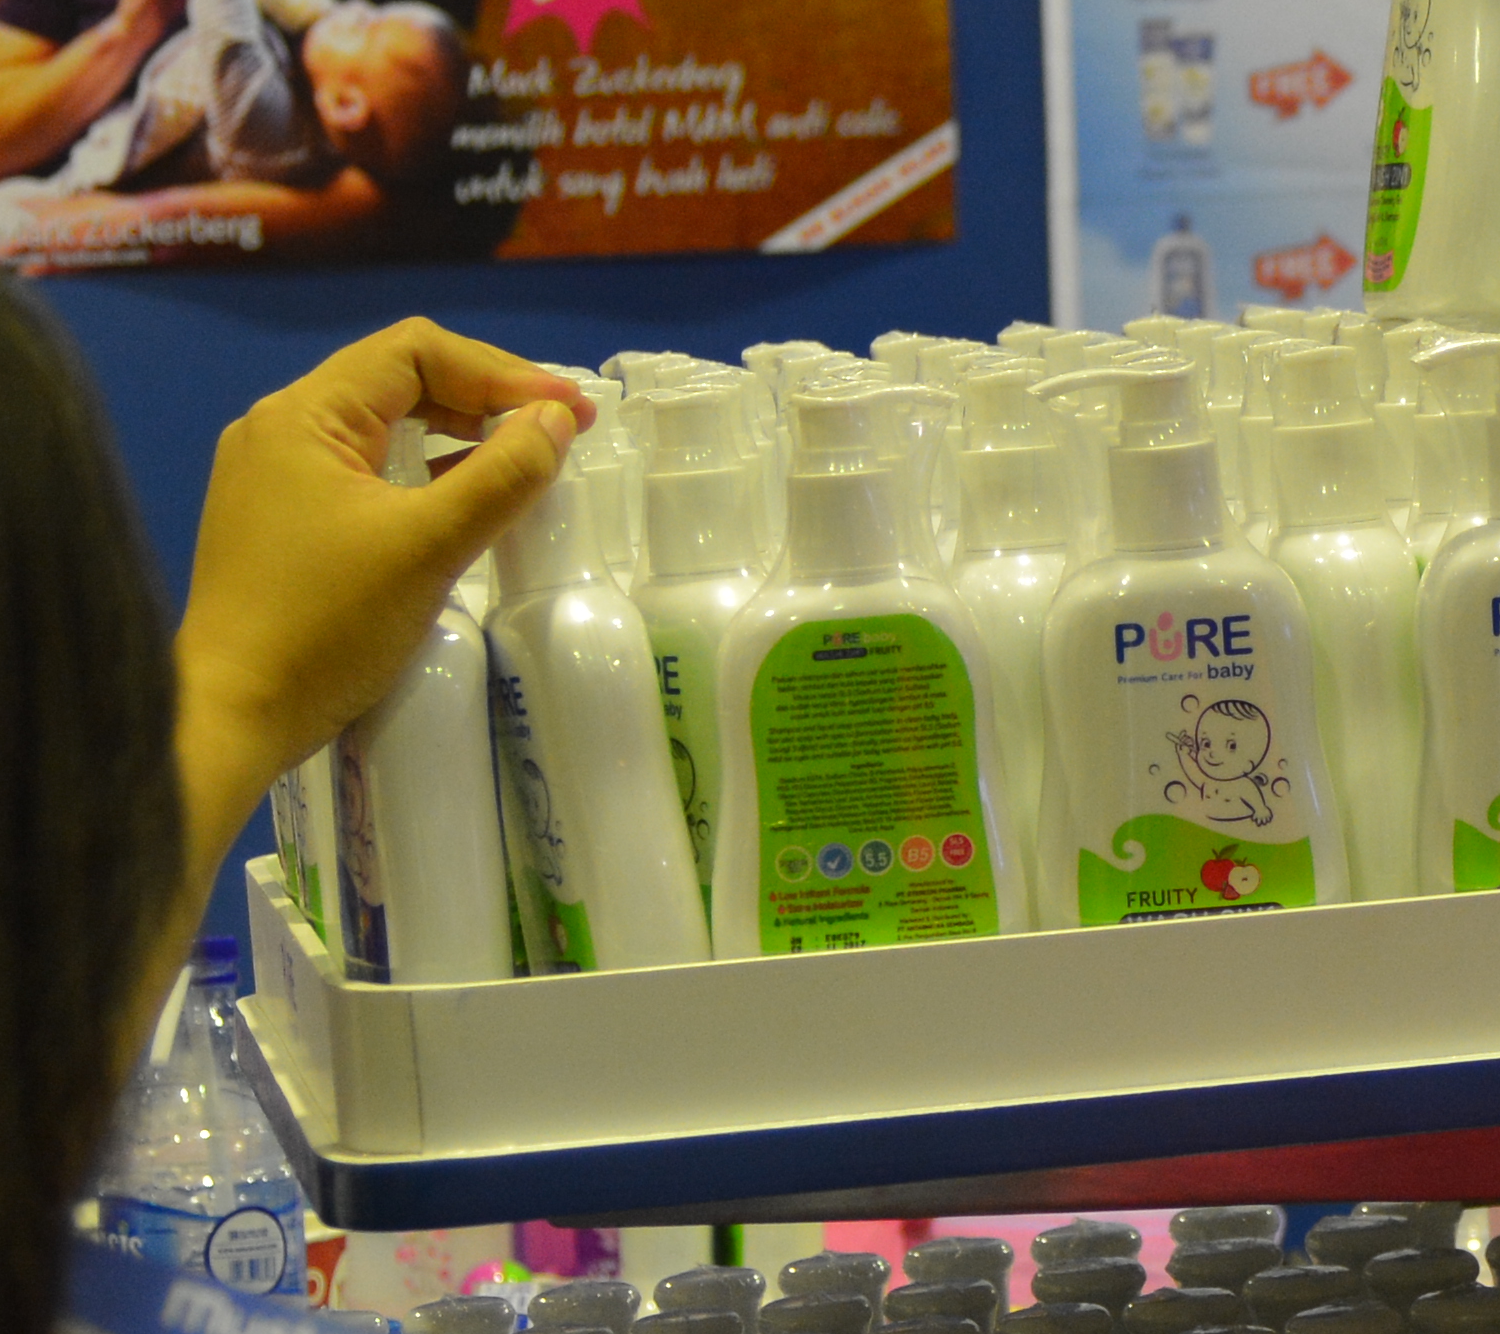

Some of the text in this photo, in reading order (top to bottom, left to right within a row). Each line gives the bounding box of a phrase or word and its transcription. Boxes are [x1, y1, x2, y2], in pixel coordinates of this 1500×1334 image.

[1114, 611, 1253, 665] PURE
[868, 645, 902, 656] FRUITY
[1117, 674, 1157, 684] Premium
[1161, 672, 1184, 682] Care
[1207, 662, 1254, 681] baby
[864, 850, 888, 867] 5.5
[906, 847, 929, 863] B5
[1126, 887, 1198, 909] FRUITY
